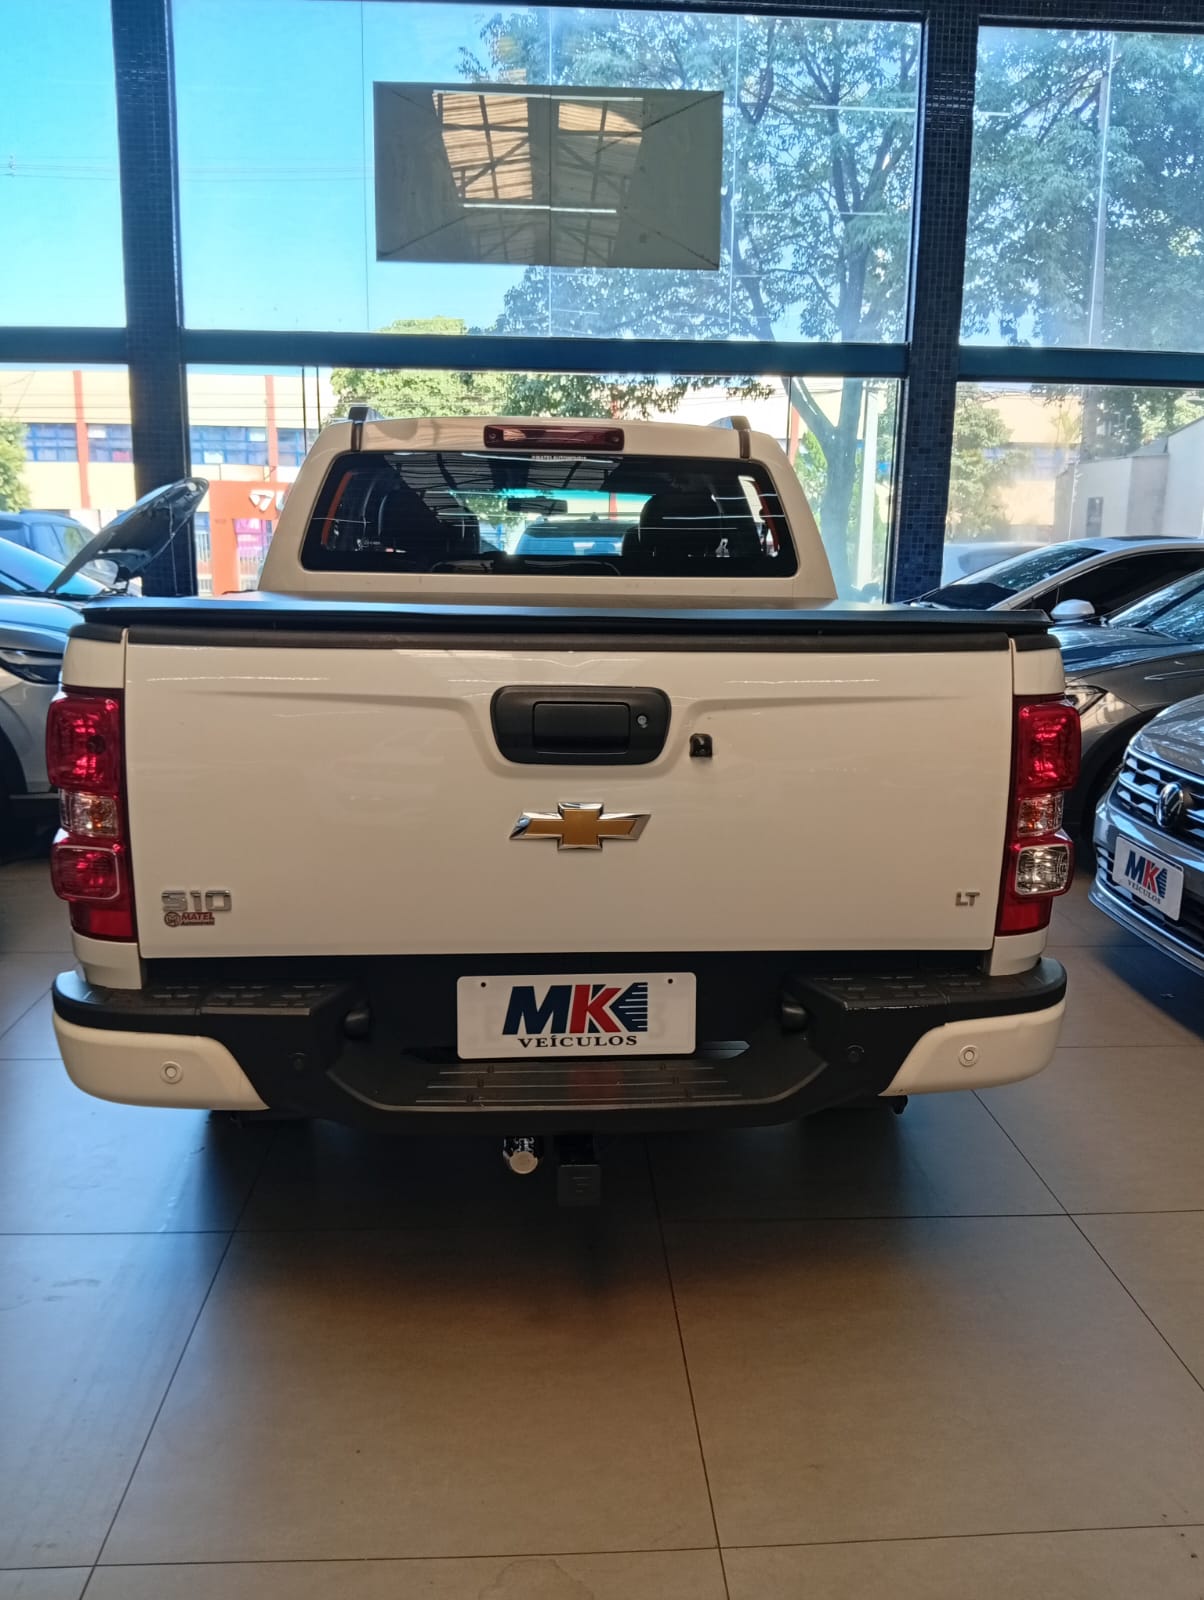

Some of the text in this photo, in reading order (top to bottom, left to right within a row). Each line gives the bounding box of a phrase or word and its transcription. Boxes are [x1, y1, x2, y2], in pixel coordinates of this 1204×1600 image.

[1125, 850, 1160, 894] MK
[161, 890, 232, 912] S10
[955, 892, 981, 907] LT
[502, 984, 622, 1035] MK
[517, 1035, 638, 1049] VEÍCULOS
